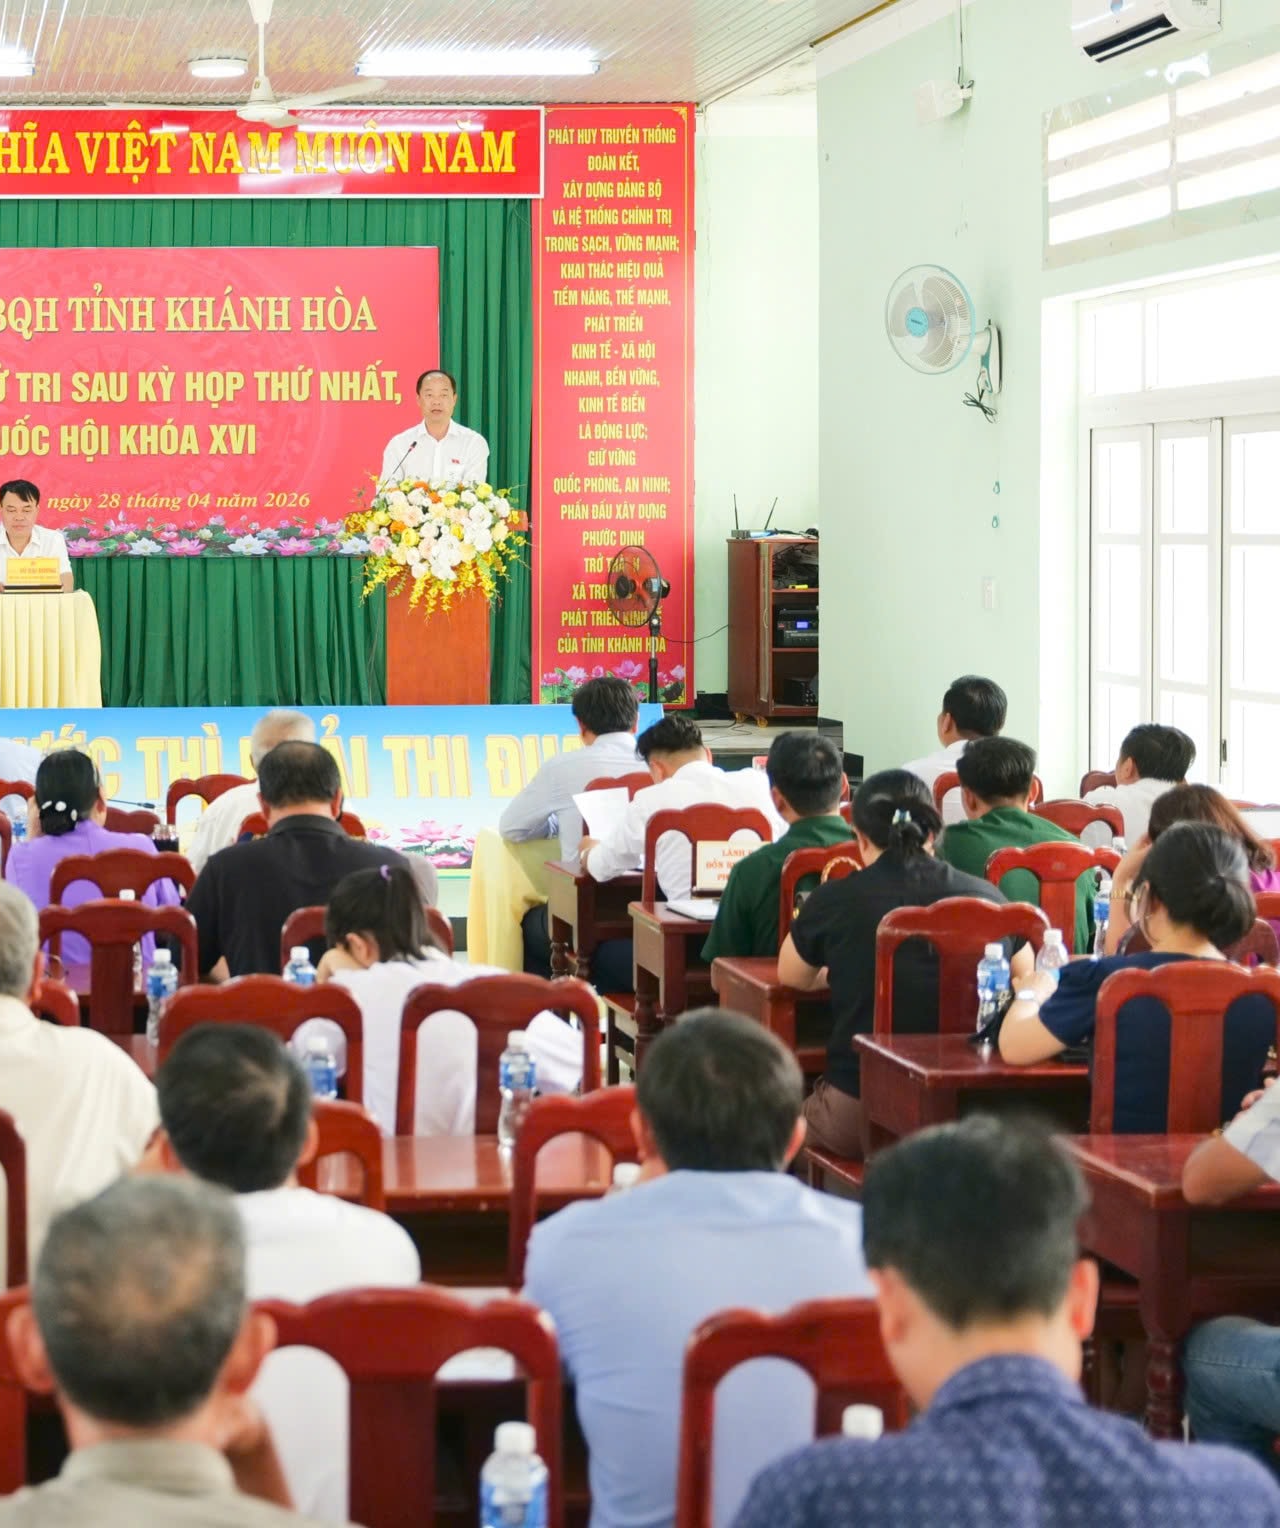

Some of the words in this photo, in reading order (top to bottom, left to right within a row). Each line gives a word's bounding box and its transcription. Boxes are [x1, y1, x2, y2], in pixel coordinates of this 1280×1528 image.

[548, 128, 575, 145] PHÁT
[577, 128, 598, 145] HUY
[599, 125, 640, 144] TRUYỀN
[642, 124, 676, 144] THỐNG
[75, 119, 178, 184] VIỆT
[189, 131, 282, 174] NAM
[293, 120, 413, 174] MUÔN
[422, 120, 516, 173] NĂM
[587, 152, 617, 172] ĐOÀN
[618, 150, 640, 173] KẾT,
[562, 179, 583, 198] XÂY
[616, 177, 646, 198] ĐẢNG
[647, 178, 662, 201] BỘ
[552, 207, 566, 225] VÀ
[568, 206, 582, 228] HỆ
[584, 205, 619, 225] THỐNG
[621, 206, 654, 225] CHÍNH
[655, 208, 672, 228] TRỊ
[544, 236, 579, 252] TRONG
[581, 236, 613, 255] SẠCH,
[615, 233, 643, 252] VỮNG
[645, 235, 680, 254] MẠNH;
[560, 263, 585, 279] KHAI
[587, 262, 614, 279] THÁC
[616, 259, 641, 282] HIỆU
[642, 257, 664, 280] QUẢ
[68, 283, 156, 332] TỈNH
[165, 286, 291, 332] KHÁNH
[301, 286, 377, 332] HÒA
[553, 287, 578, 306] TIỀM
[581, 287, 613, 306] NĂNG,
[615, 286, 635, 305] THẾ
[637, 289, 672, 308] MẠNH,
[584, 313, 611, 333] PHÁT
[613, 310, 644, 333] TRIỂN
[571, 343, 597, 359] KINH
[599, 339, 612, 359] TẾ
[621, 340, 636, 359] XÃ
[637, 339, 656, 362] HỘI
[16, 372, 61, 403] TRI
[71, 372, 128, 403] SAU
[138, 365, 176, 402] KỲ
[186, 371, 245, 409] HỌP
[254, 365, 313, 402] THỨ
[320, 360, 402, 405] NHẤT,
[564, 370, 603, 387] NHANH,
[605, 366, 627, 386] BỀN
[629, 367, 660, 387] VỮNG,
[578, 396, 604, 413] KINH
[606, 393, 619, 413] TẾ
[620, 390, 646, 413] BIỂN
[60, 419, 109, 462] HỘI
[120, 418, 200, 456] KHÓA
[208, 424, 256, 455] XVI
[579, 423, 592, 440] LÀ
[593, 420, 623, 442] ĐỘNG
[625, 422, 648, 443] LỰC;
[588, 447, 608, 467] GIỮ
[607, 447, 637, 467] VỮNG
[553, 474, 581, 494] QUỐC
[583, 476, 623, 494] PHÒNG,
[624, 476, 640, 493] AN
[642, 476, 671, 493] NINH;
[47, 497, 92, 511] ngày
[97, 493, 121, 509] 28
[127, 493, 181, 511] tháng
[187, 493, 210, 508] 04
[217, 493, 258, 508] năm
[264, 493, 311, 508] 2026
[560, 501, 590, 520] PHẤN
[591, 500, 613, 520] ĐẤU
[615, 500, 636, 520] XÂY
[582, 527, 617, 547] PHƯỚC
[619, 530, 645, 546] DINH
[583, 552, 605, 573] TRỞ
[571, 582, 587, 600] XÃ
[561, 607, 588, 627] PHÁT
[557, 632, 579, 654] CỦA
[581, 632, 605, 653] TỈNH
[607, 634, 643, 653] KHÁNH
[136, 722, 224, 799] THÌ
[382, 734, 471, 799] THI
